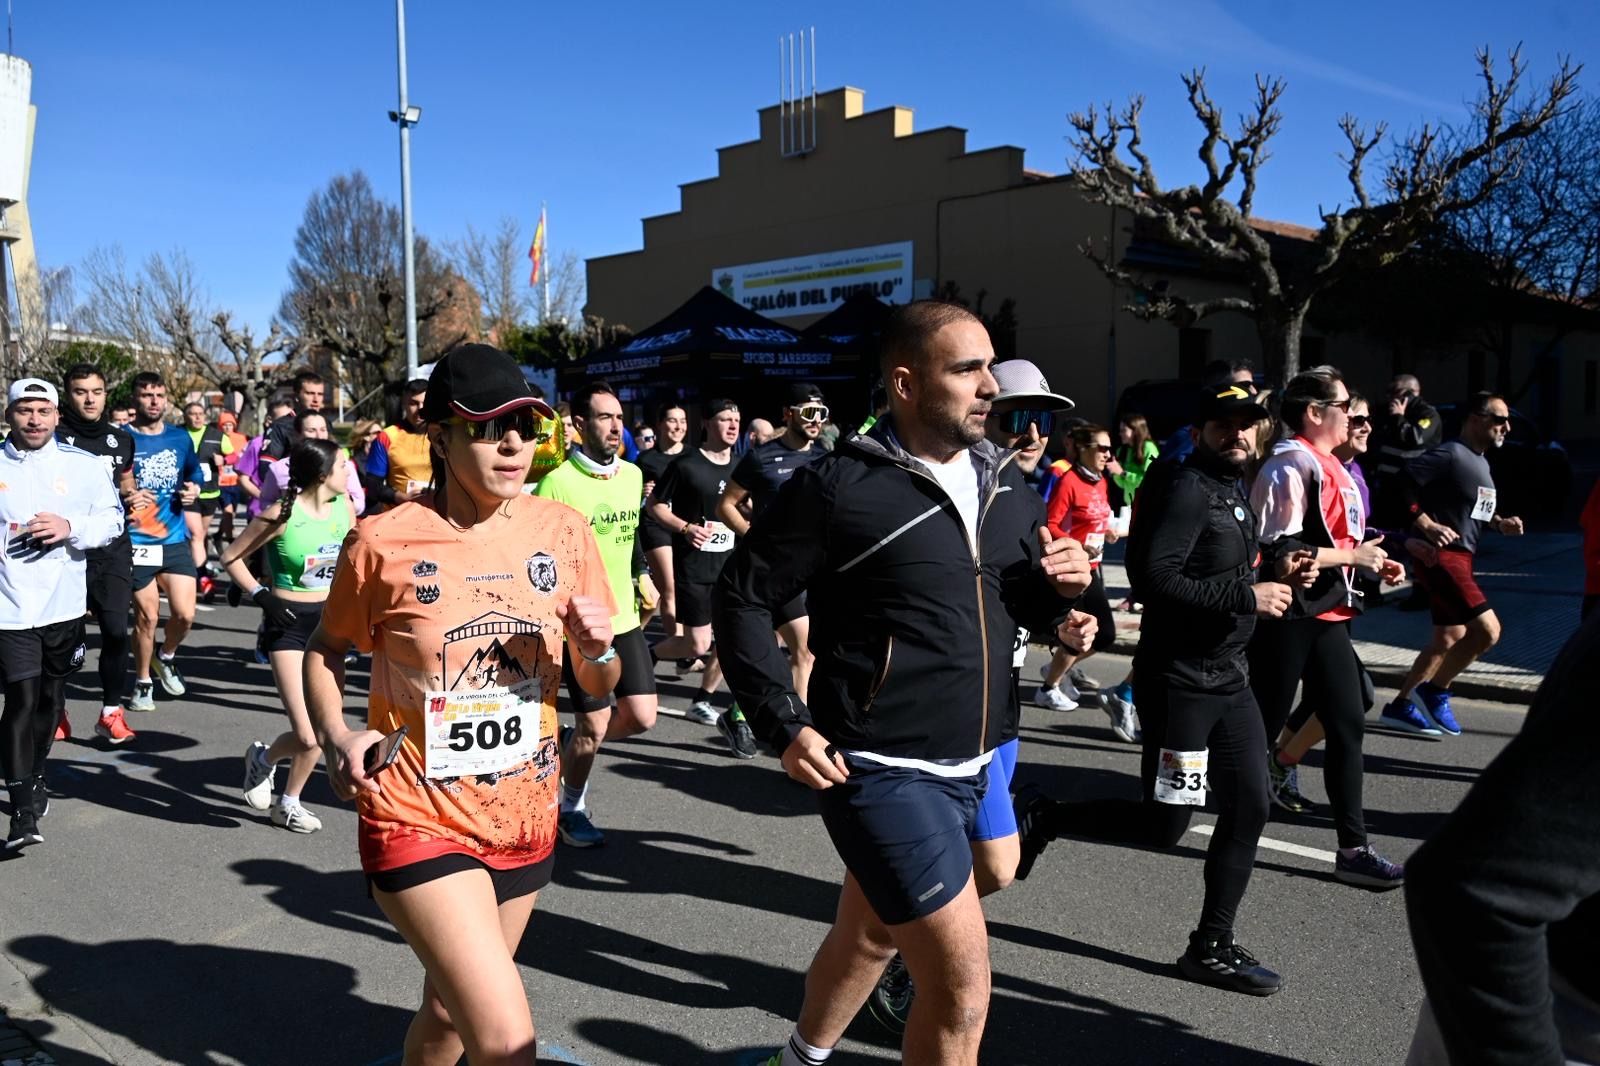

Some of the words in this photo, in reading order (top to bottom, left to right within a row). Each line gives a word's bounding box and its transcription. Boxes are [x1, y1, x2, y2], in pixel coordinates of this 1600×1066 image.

[799, 287, 827, 306] DEL
[743, 352, 775, 365] SPORTS
[448, 715, 522, 752] 508
